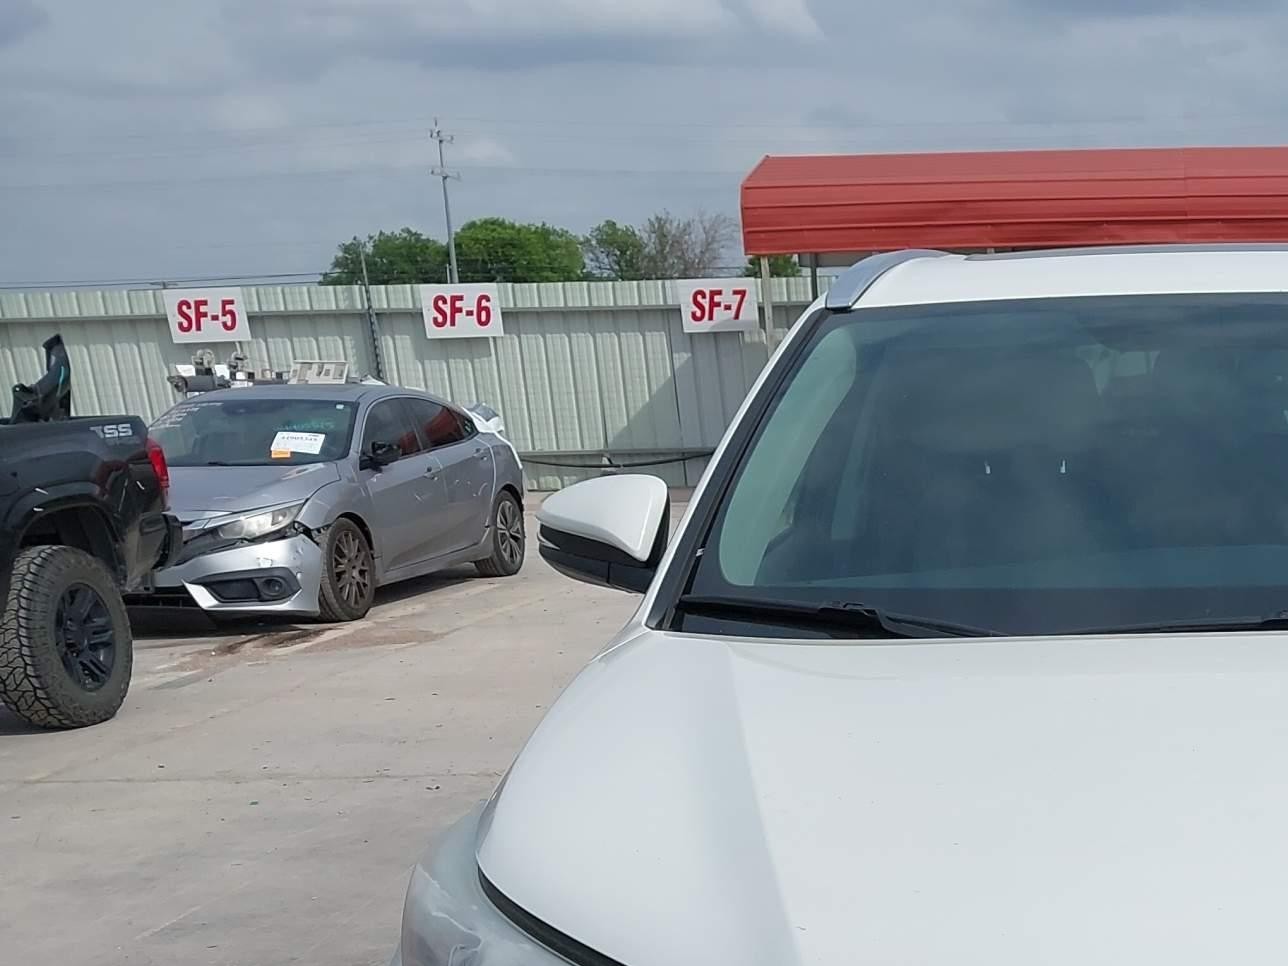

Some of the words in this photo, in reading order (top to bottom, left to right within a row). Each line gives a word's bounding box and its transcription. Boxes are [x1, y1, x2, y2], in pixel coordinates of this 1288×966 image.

[177, 299, 237, 333] SF-5
[432, 294, 491, 328] SF-6
[690, 289, 747, 322] SF-7
